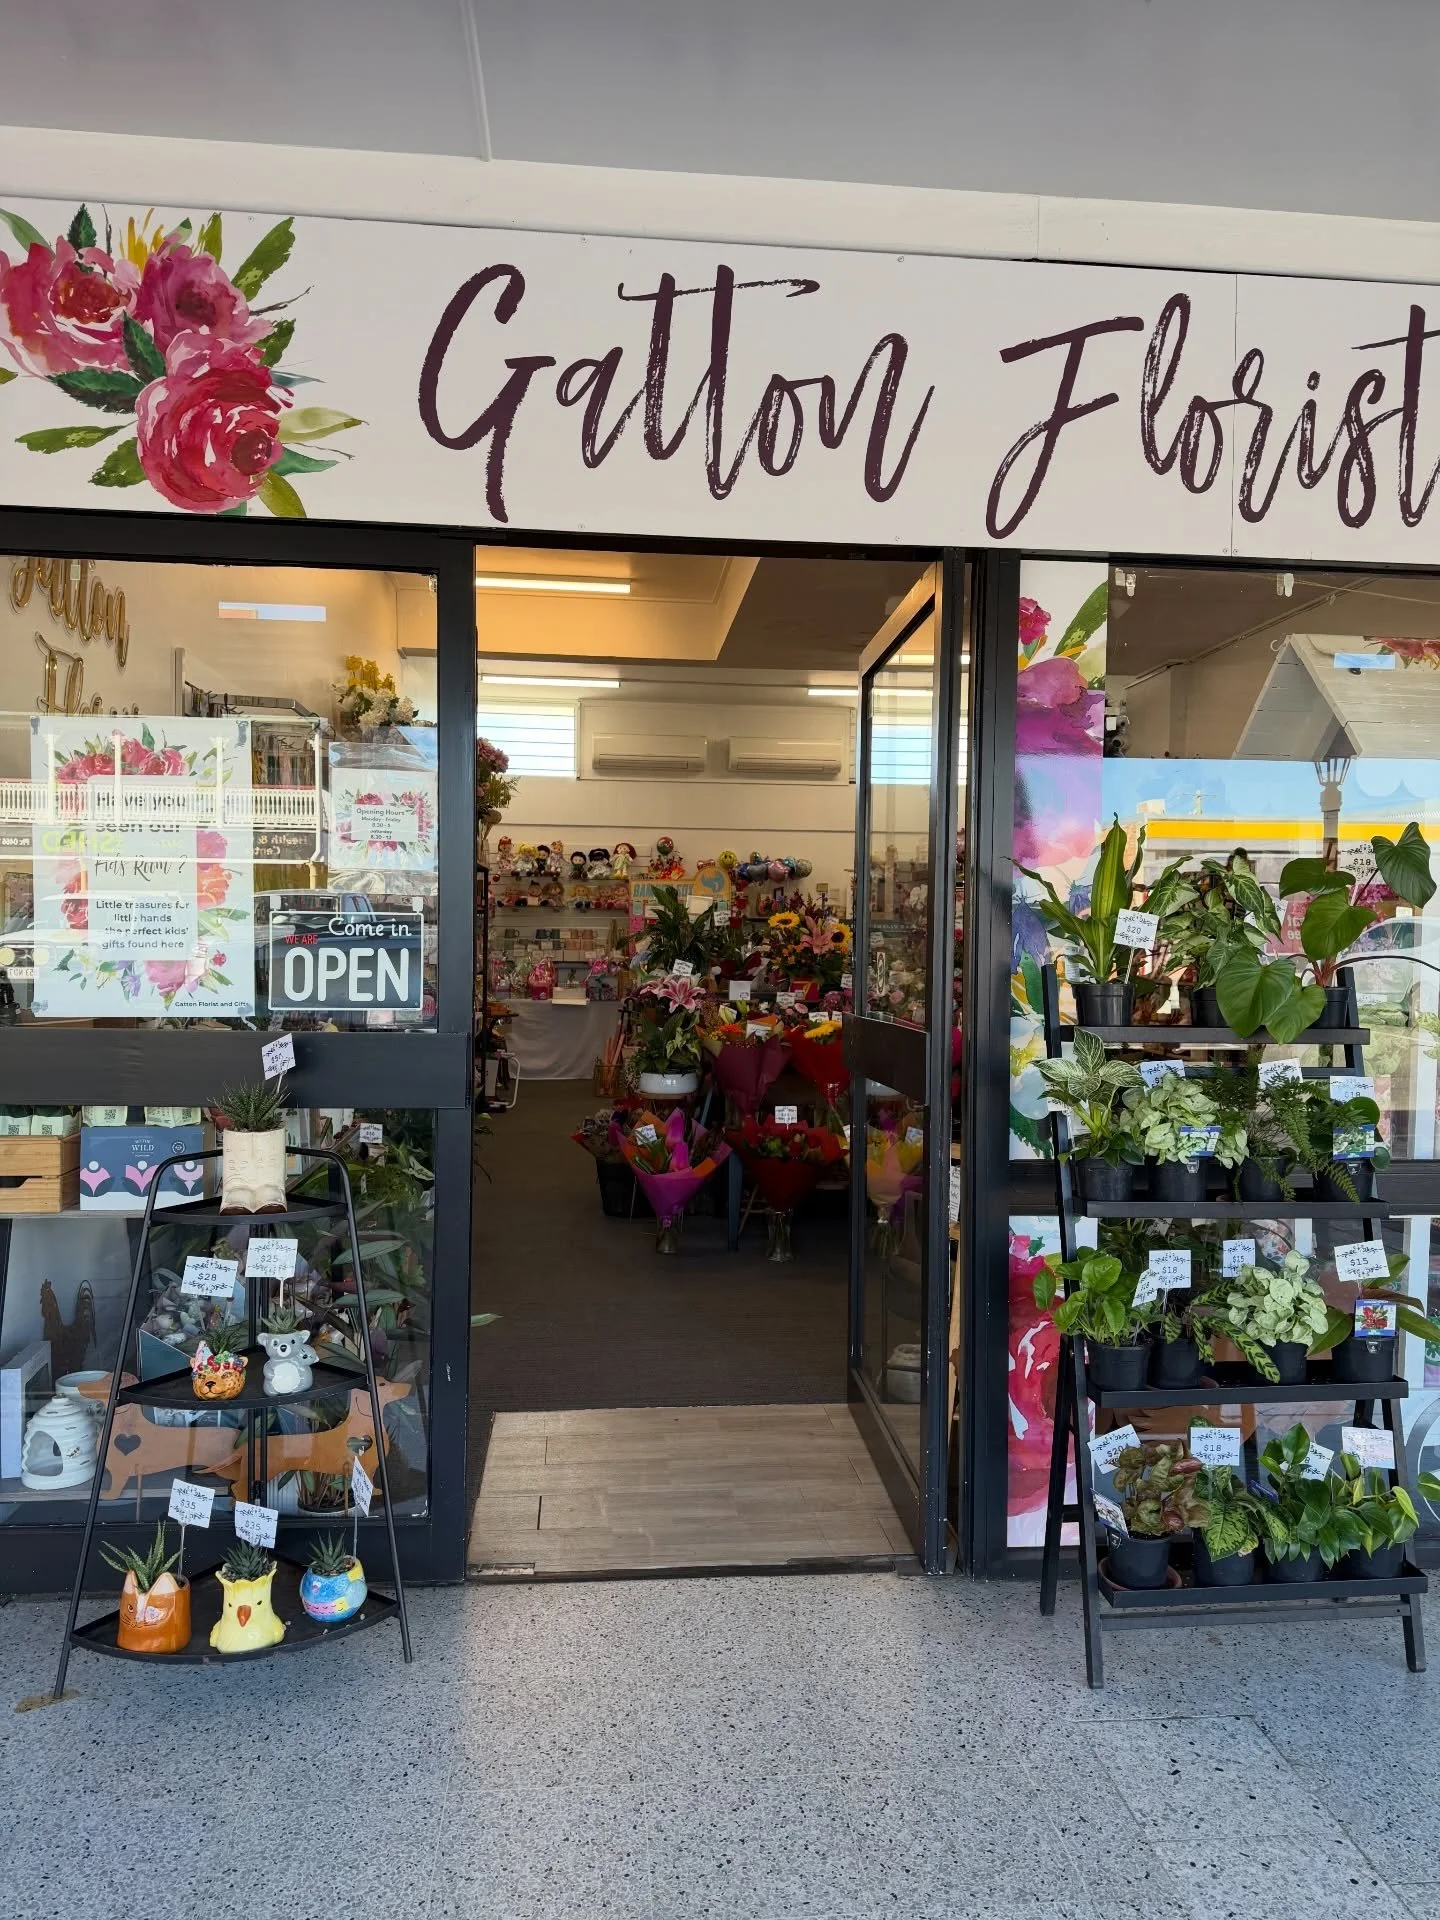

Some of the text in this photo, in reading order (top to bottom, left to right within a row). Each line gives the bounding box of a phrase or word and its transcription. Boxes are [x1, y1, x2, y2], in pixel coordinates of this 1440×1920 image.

[417, 262, 1440, 539] Gatton Florist
[356, 808, 384, 816] Opening
[1353, 858, 1371, 866] $18
[96, 900, 190, 909] Little treasures for
[140, 914, 172, 922] hands
[328, 917, 412, 936] Come in
[1126, 925, 1141, 934] $20
[284, 934, 318, 945] WE ARE
[102, 940, 184, 949] gifts found here
[284, 947, 409, 1002] OPEN
[260, 1254, 279, 1263] $25
[1350, 1258, 1369, 1266] $15
[1162, 1266, 1177, 1274] $18
[198, 1272, 217, 1281] $28
[1204, 1444, 1221, 1452] $18
[180, 1499, 196, 1509] $35
[244, 1520, 261, 1530] $35
